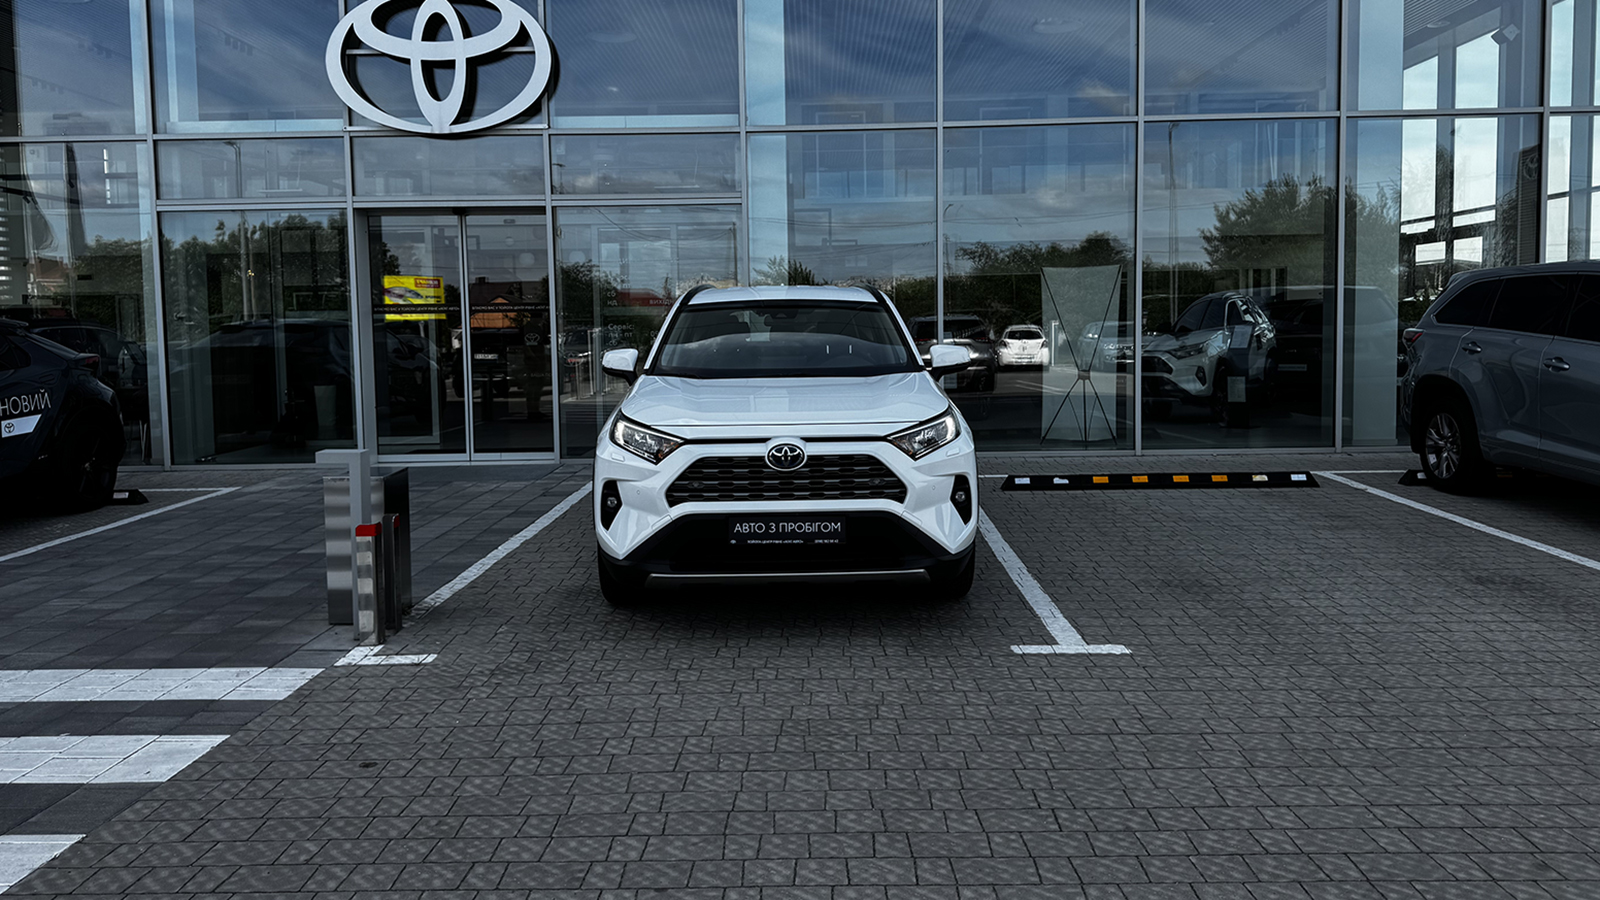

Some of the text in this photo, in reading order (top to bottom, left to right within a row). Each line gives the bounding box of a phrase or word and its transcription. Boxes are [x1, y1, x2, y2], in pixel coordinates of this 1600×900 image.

[0, 388, 52, 416] НОВИЙ
[733, 522, 841, 533] АВТО З ПРОБІГОМ
